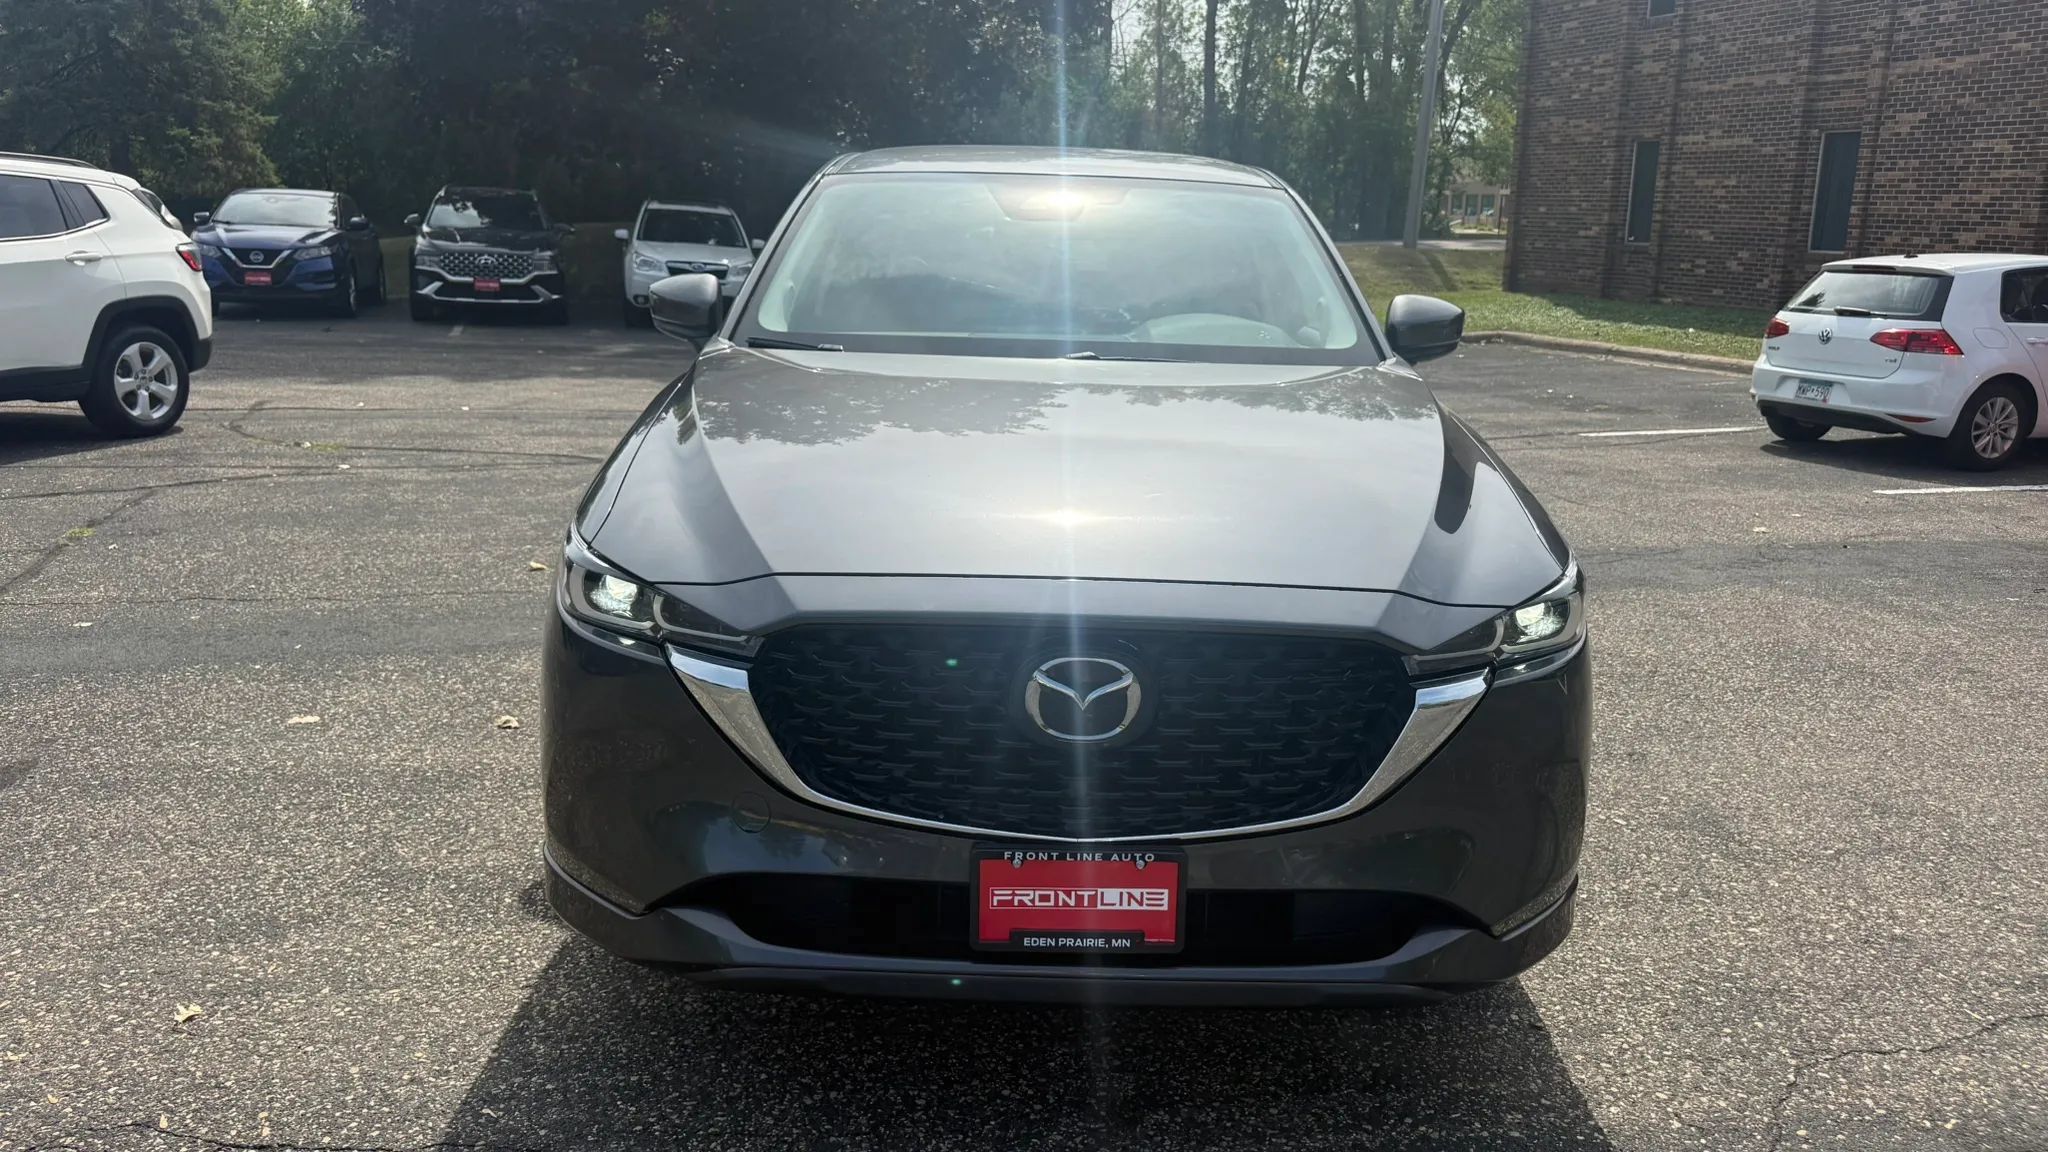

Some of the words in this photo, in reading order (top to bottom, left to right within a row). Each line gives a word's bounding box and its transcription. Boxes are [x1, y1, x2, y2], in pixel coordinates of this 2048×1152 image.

[1004, 851, 1059, 861] FRONT
[1066, 852, 1102, 862] LINE
[1110, 853, 1155, 862] AUTO
[992, 889, 1165, 908] FRONTLINE
[1023, 937, 1056, 948] EDEN
[1058, 937, 1109, 949] PRAIRIE,
[1111, 938, 1131, 948] MN
